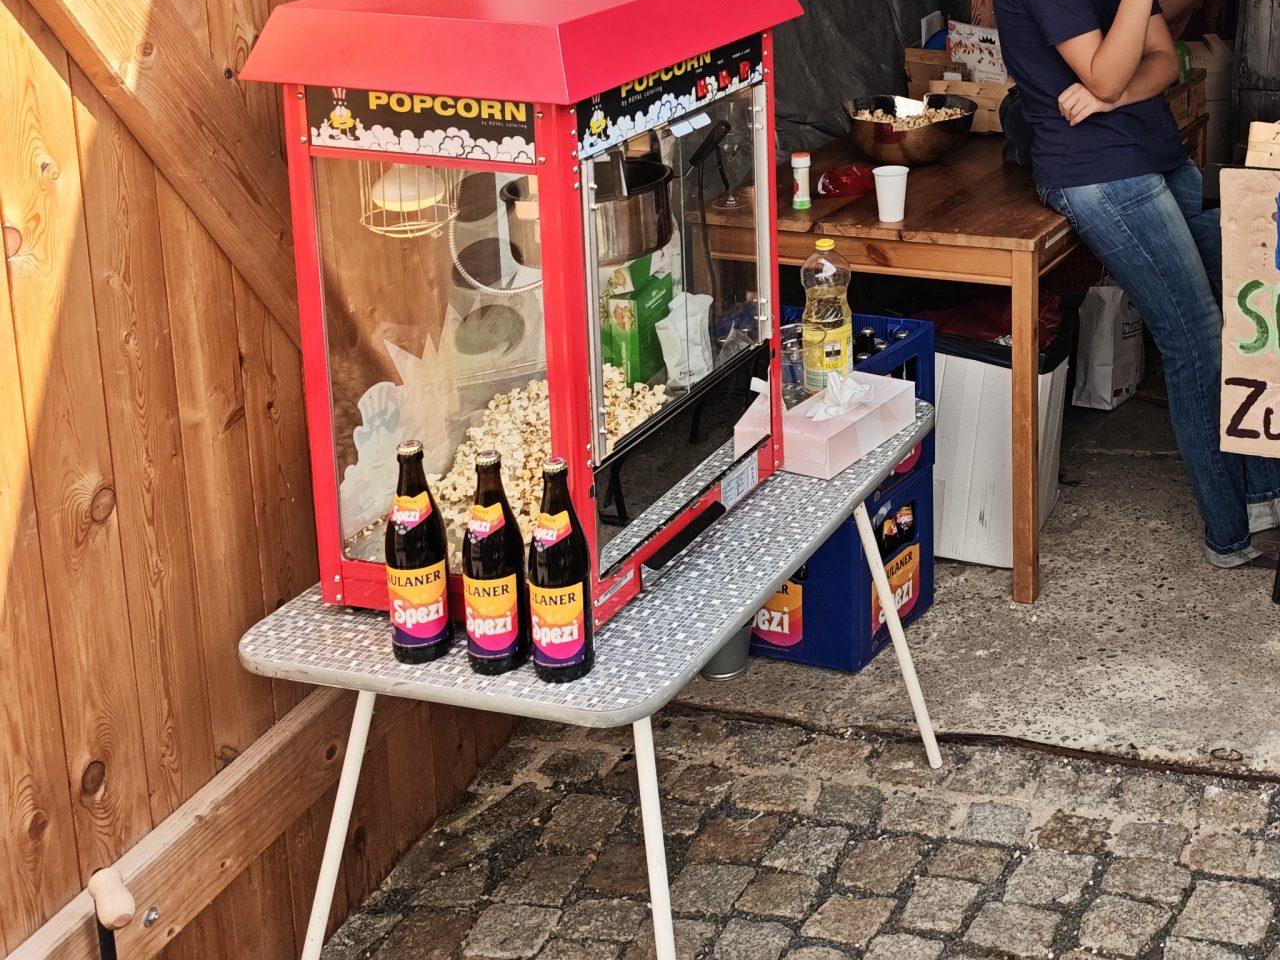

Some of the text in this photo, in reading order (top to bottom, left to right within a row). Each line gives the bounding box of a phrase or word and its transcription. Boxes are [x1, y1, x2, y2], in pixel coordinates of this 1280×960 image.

[620, 50, 712, 99] POPCORN
[368, 90, 528, 122] POPCORN
[886, 551, 913, 579] ULANER
[393, 597, 444, 628] Spezi
[466, 606, 512, 639] Spezi
[532, 615, 579, 647] Spezi
